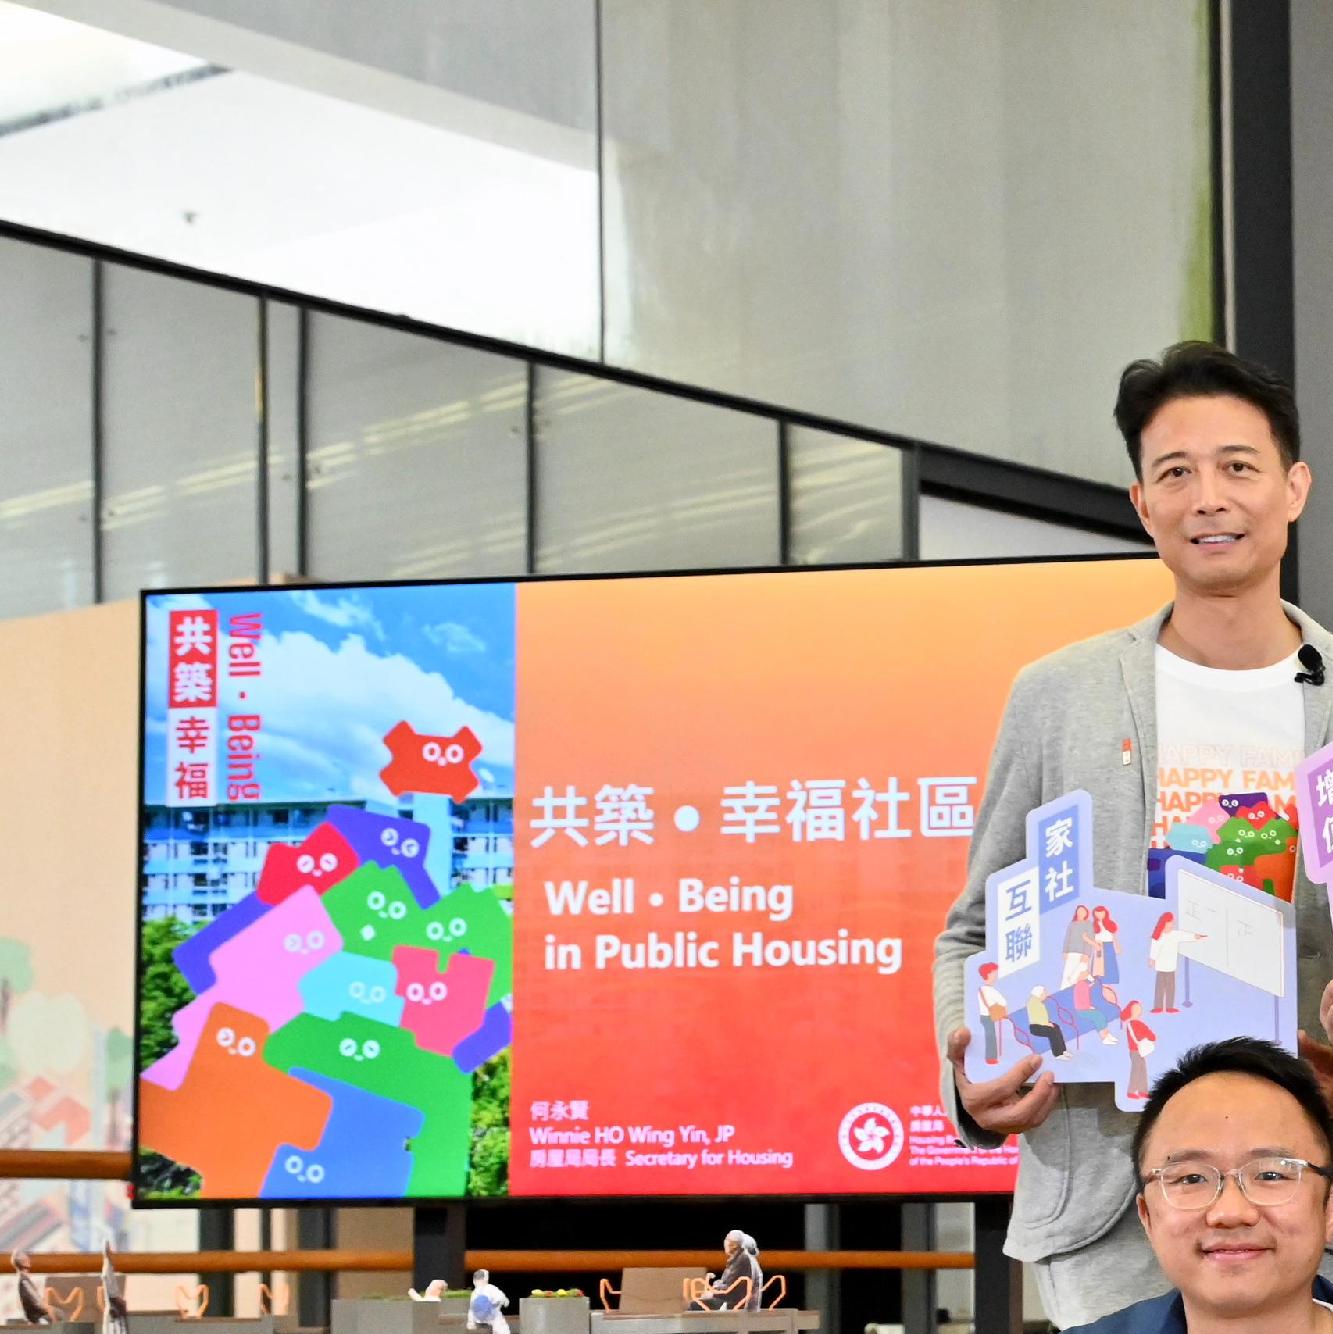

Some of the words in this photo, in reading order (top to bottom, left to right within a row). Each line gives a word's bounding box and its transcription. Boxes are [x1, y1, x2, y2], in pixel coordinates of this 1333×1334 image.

[227, 612, 263, 677] Well
[172, 616, 214, 800] 共築幸福
[226, 714, 263, 802] Being
[1044, 819, 1074, 903] 家社
[544, 882, 634, 915] Well
[679, 878, 794, 920] Being
[1004, 878, 1035, 962] 互聯
[544, 937, 581, 970] in
[595, 932, 719, 970] Public
[733, 929, 903, 974] Housing
[529, 1126, 591, 1145] Winnie
[594, 1126, 624, 1144] HO
[628, 1126, 674, 1148] Wing
[678, 1125, 711, 1146] Yin,
[713, 1125, 735, 1143] JP
[624, 1150, 699, 1170] Secretary
[701, 1149, 724, 1167] for
[727, 1149, 794, 1169] Housing
